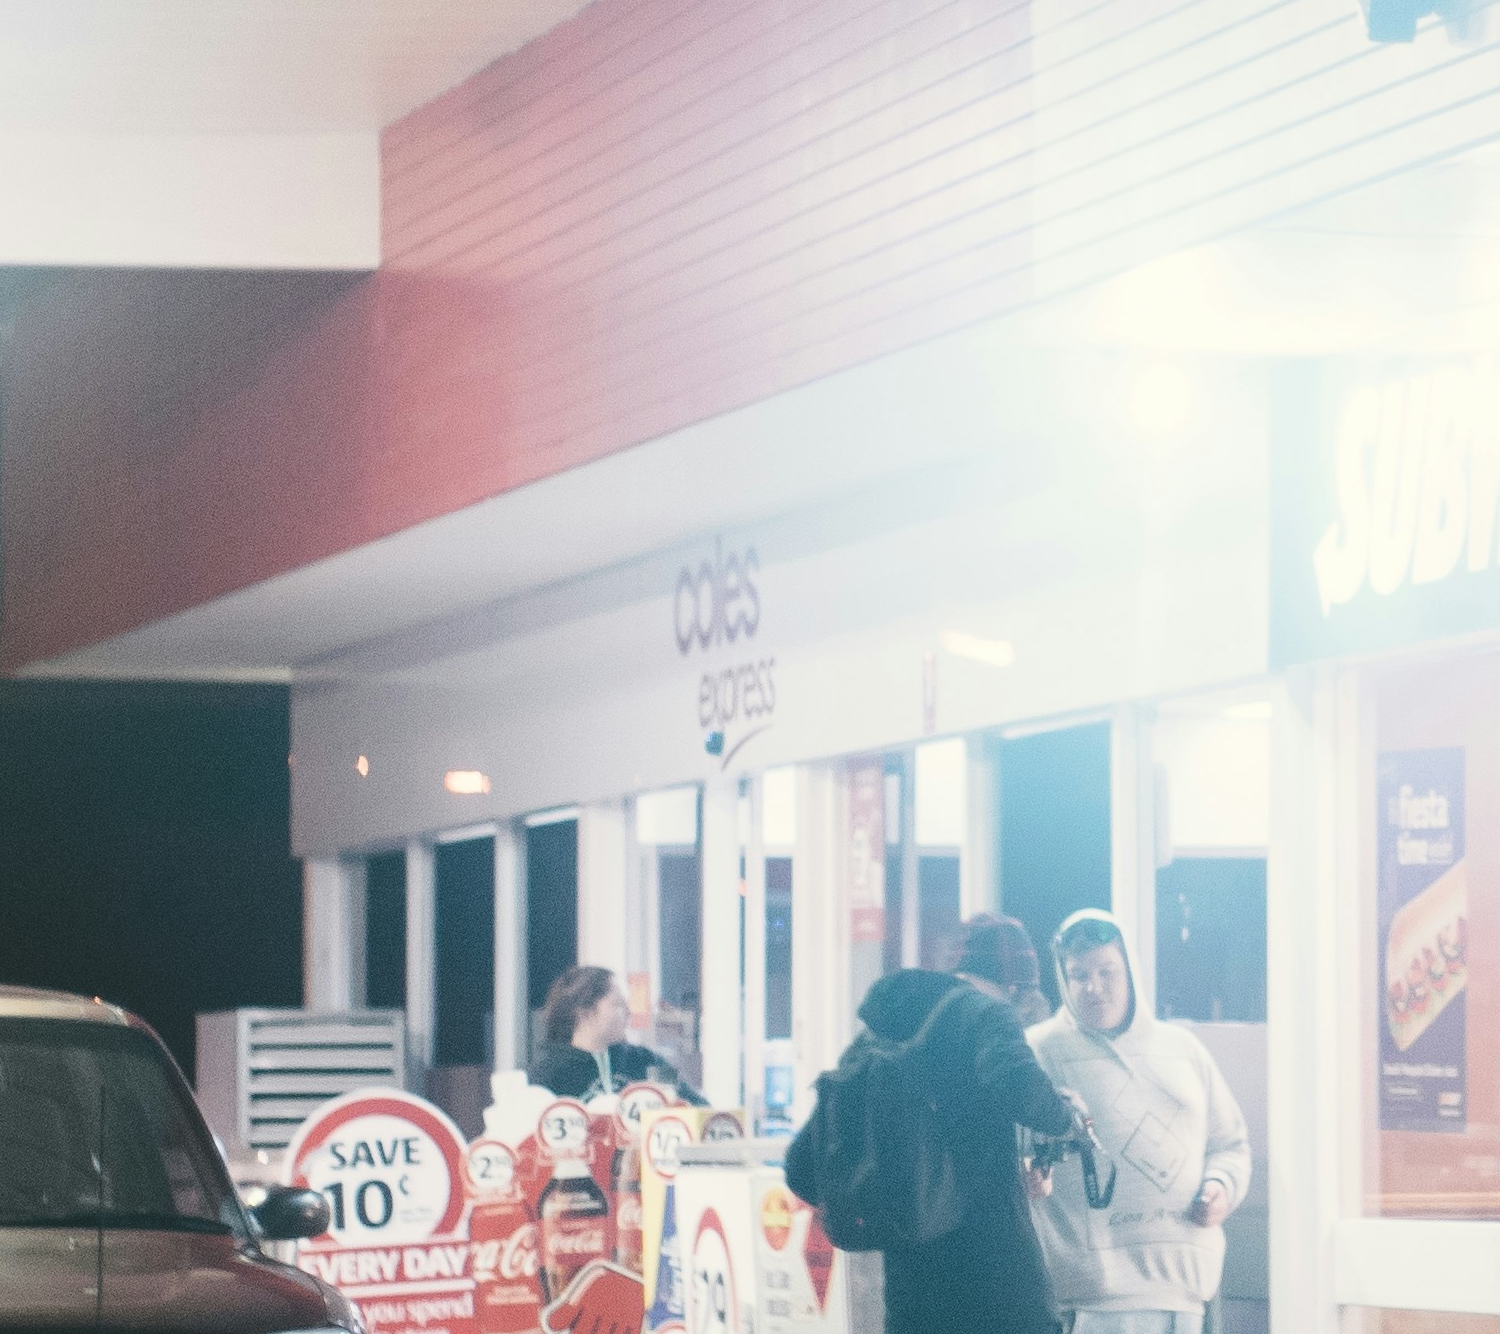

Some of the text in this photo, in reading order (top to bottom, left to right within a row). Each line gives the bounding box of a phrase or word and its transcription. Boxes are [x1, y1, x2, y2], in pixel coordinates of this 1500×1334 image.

[674, 534, 761, 656] coles
[698, 657, 775, 729] express
[329, 1137, 421, 1171] SAVE
[299, 1250, 400, 1286] EVERY
[403, 1245, 469, 1280] DAY
[406, 1292, 475, 1328] spend
